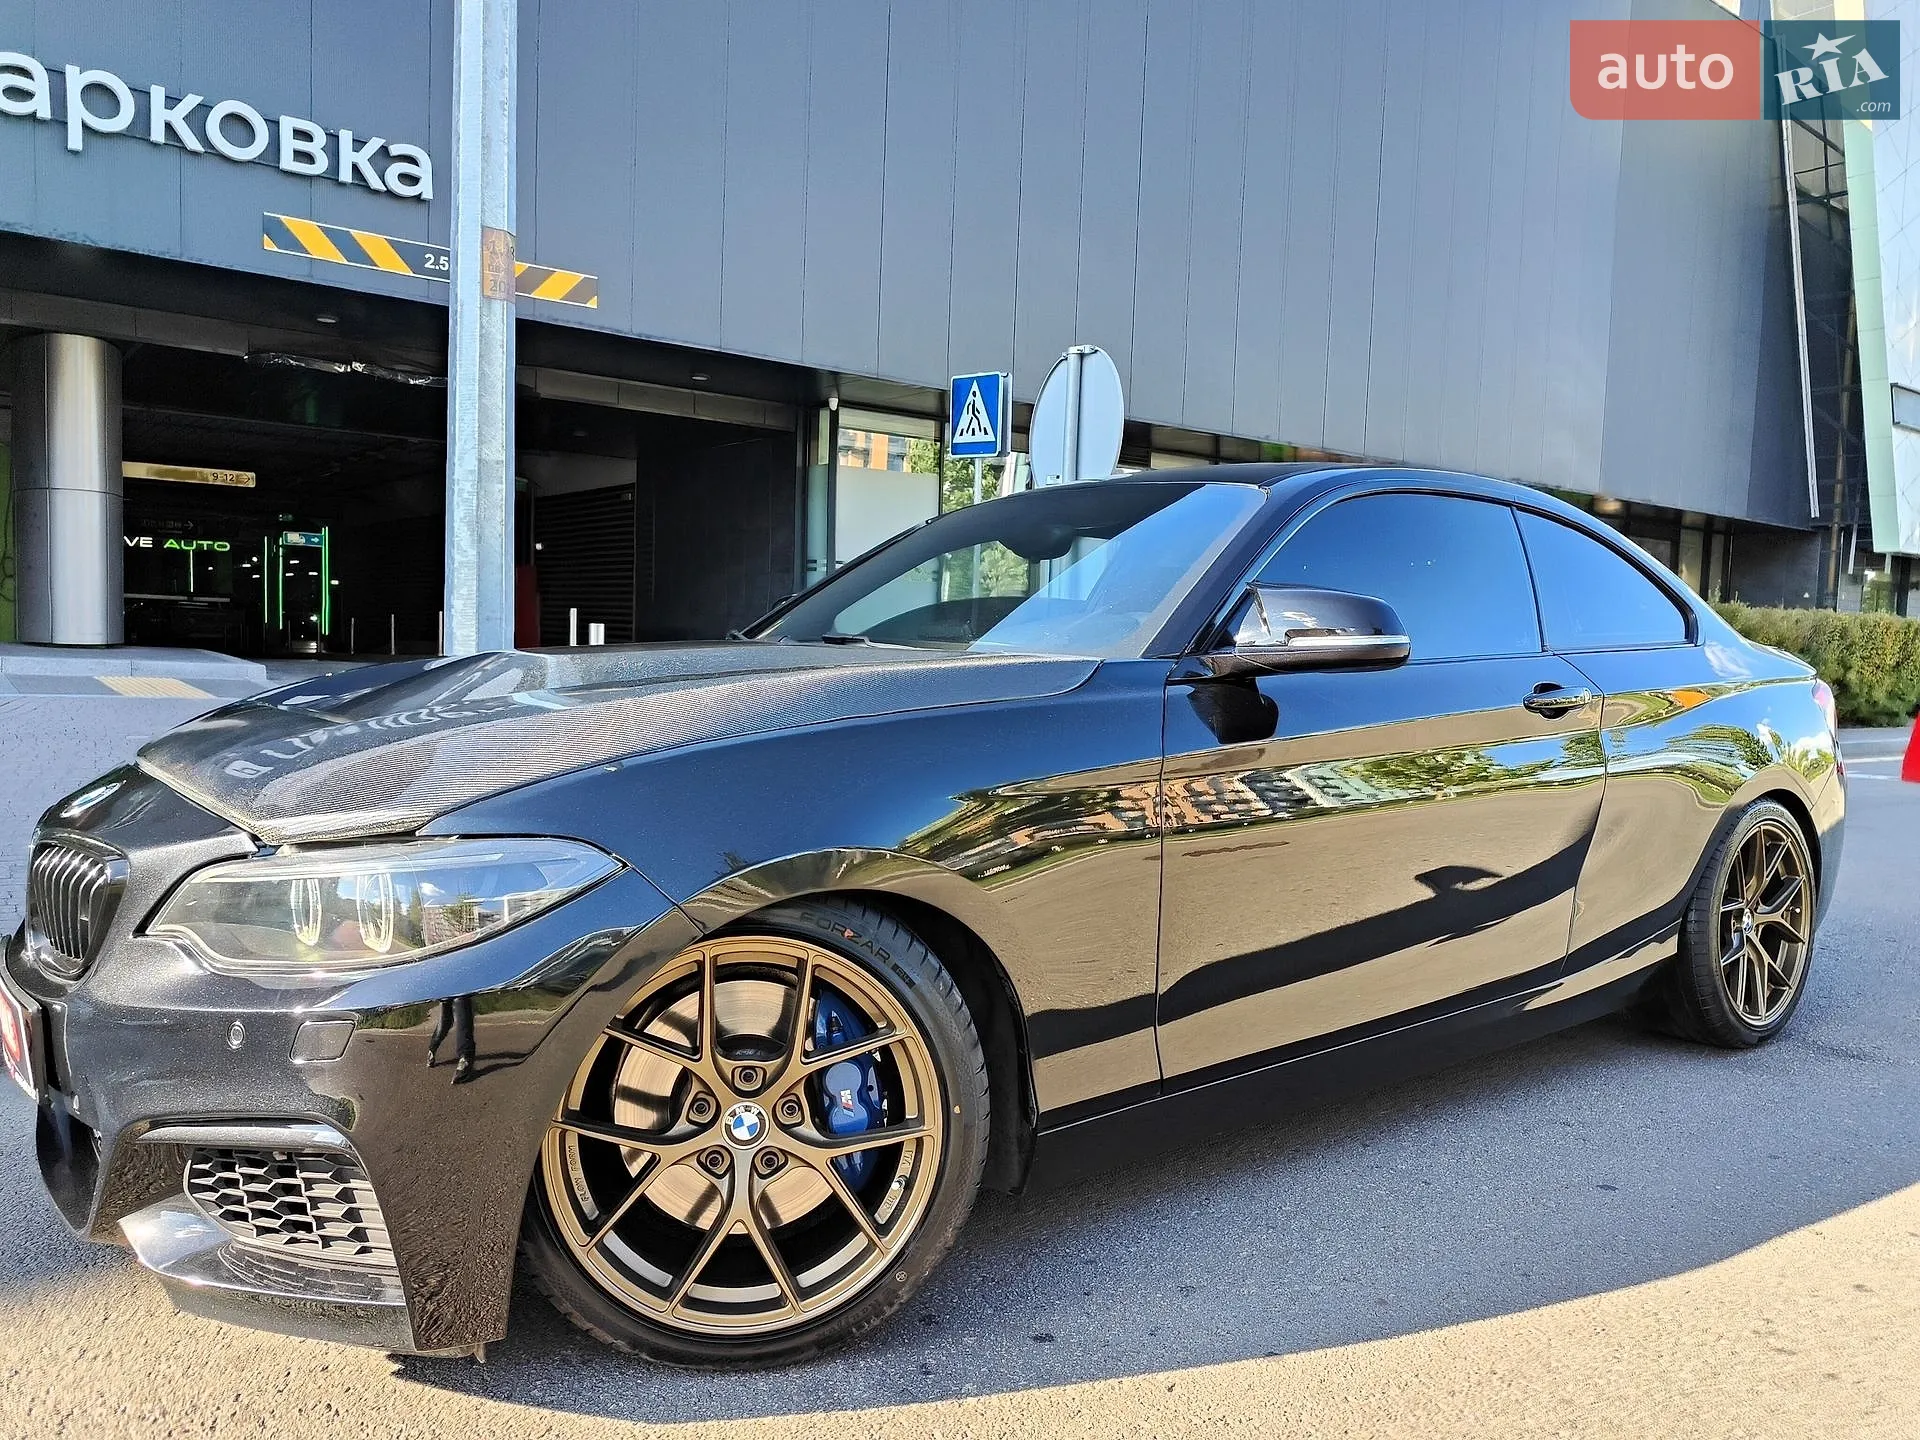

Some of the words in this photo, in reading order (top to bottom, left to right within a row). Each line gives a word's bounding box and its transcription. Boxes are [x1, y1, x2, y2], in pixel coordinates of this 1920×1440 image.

[0, 51, 434, 201] арковка
[424, 253, 450, 271] 2.5
[212, 472, 235, 482] 9-12
[163, 539, 231, 552] AUTO
